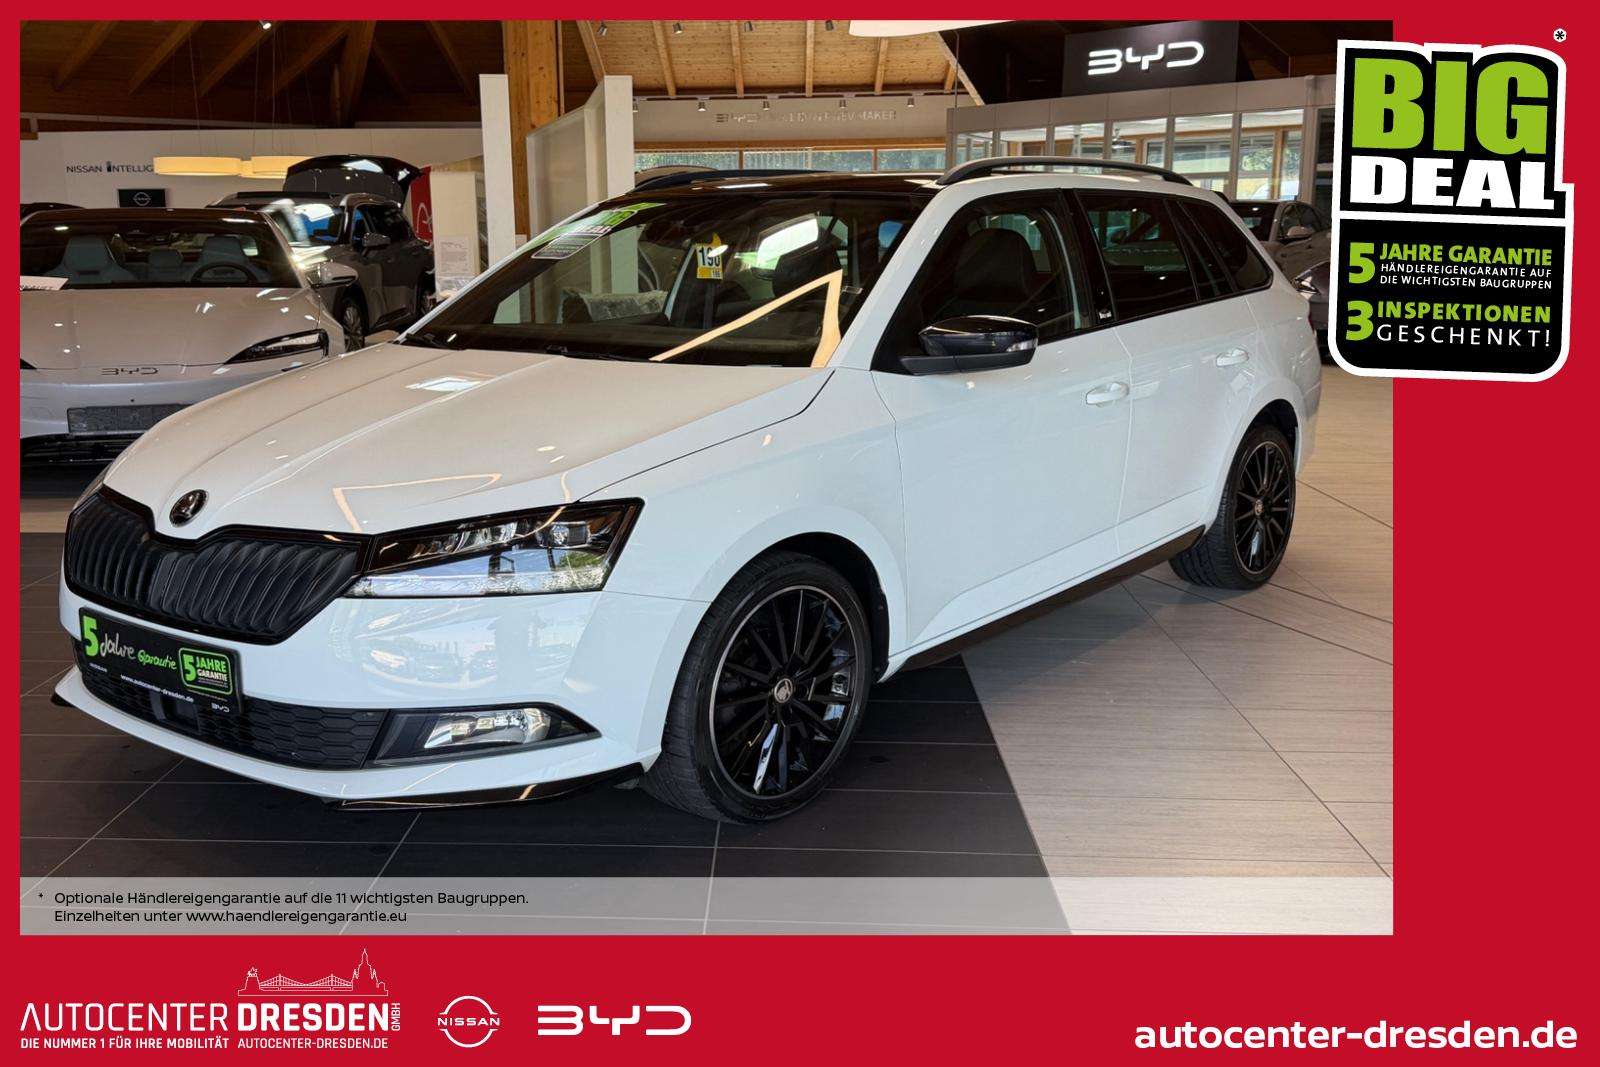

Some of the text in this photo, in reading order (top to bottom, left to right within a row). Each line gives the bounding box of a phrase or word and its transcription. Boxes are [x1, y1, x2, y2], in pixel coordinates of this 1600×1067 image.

[1088, 41, 1205, 76] BYD
[66, 165, 102, 174] NISSAN
[102, 367, 158, 376] BYD
[83, 615, 98, 657] 5
[100, 632, 136, 660] Jahre
[182, 654, 227, 681] 5 JAHRE
[196, 668, 229, 682] GARANTIE
